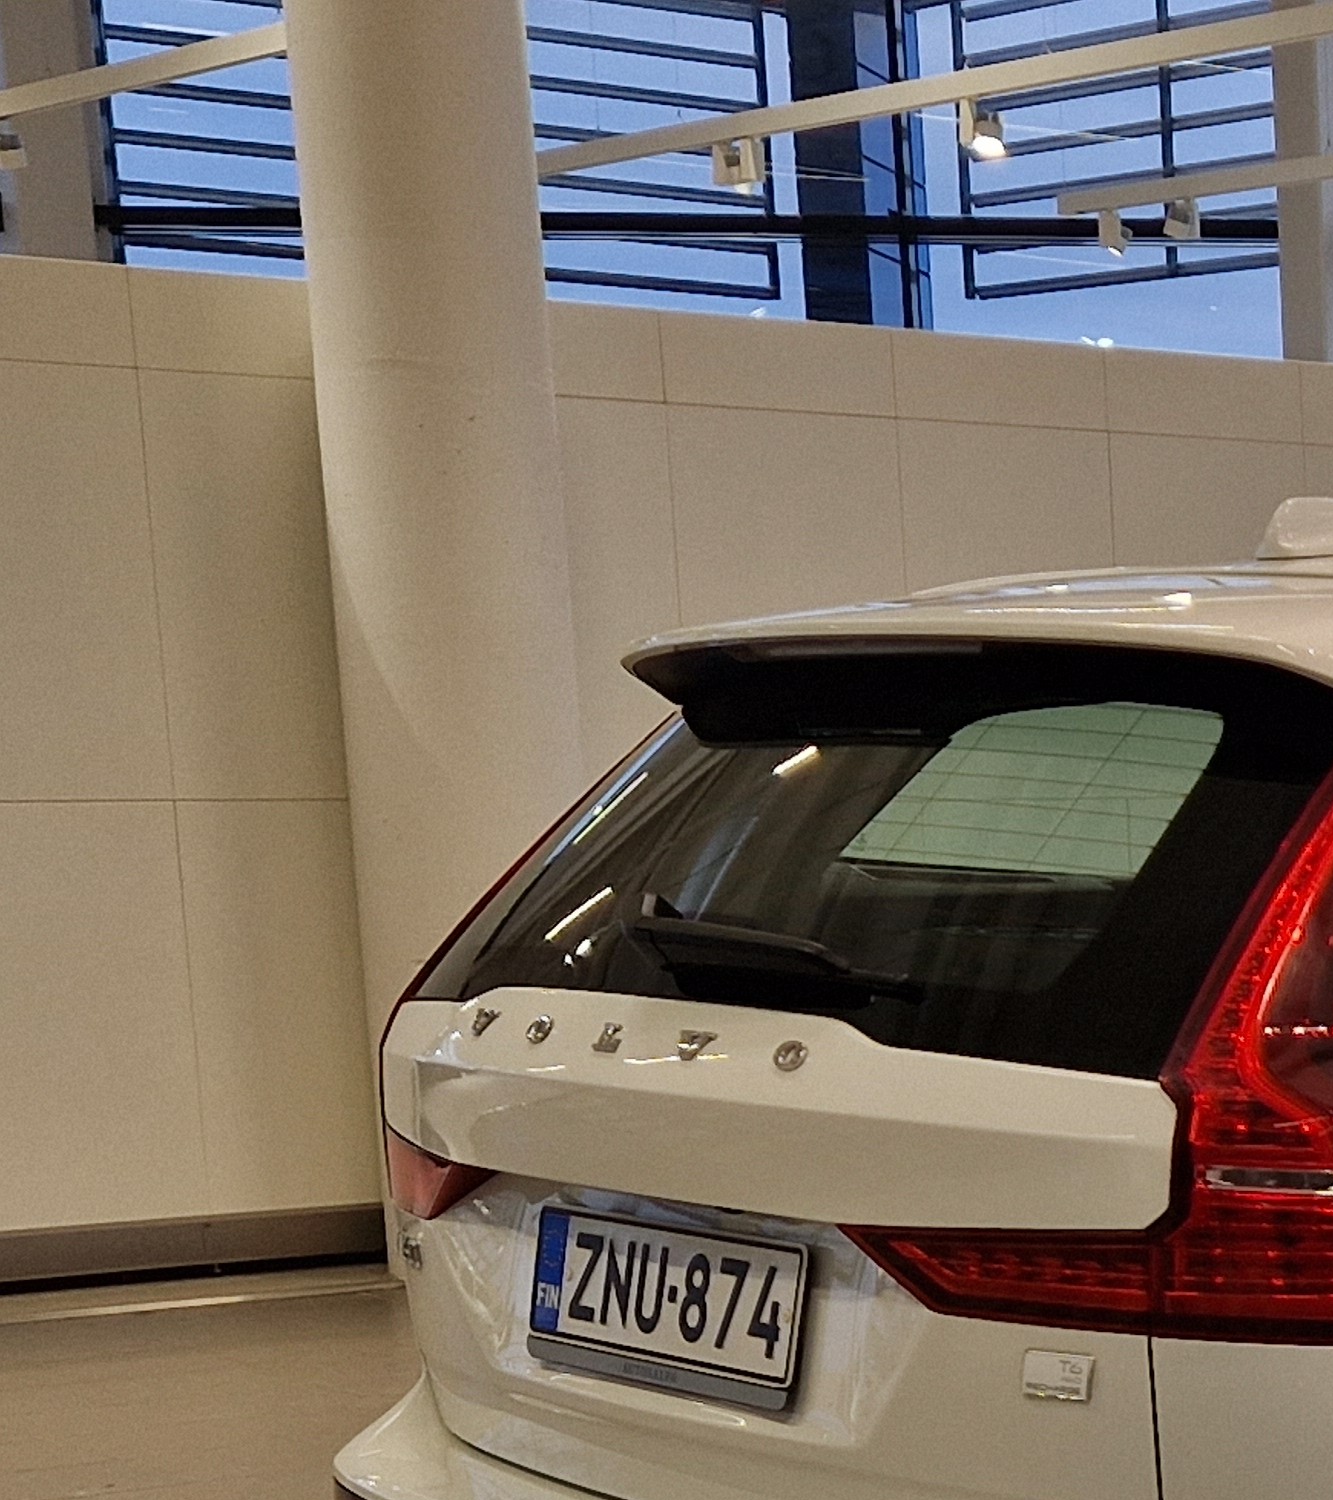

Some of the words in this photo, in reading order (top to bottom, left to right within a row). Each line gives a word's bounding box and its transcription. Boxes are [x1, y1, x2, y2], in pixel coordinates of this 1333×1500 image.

[472, 1007, 809, 1071] VOLVO
[536, 1281, 560, 1310] FIN
[567, 1232, 781, 1360] ZNU-874
